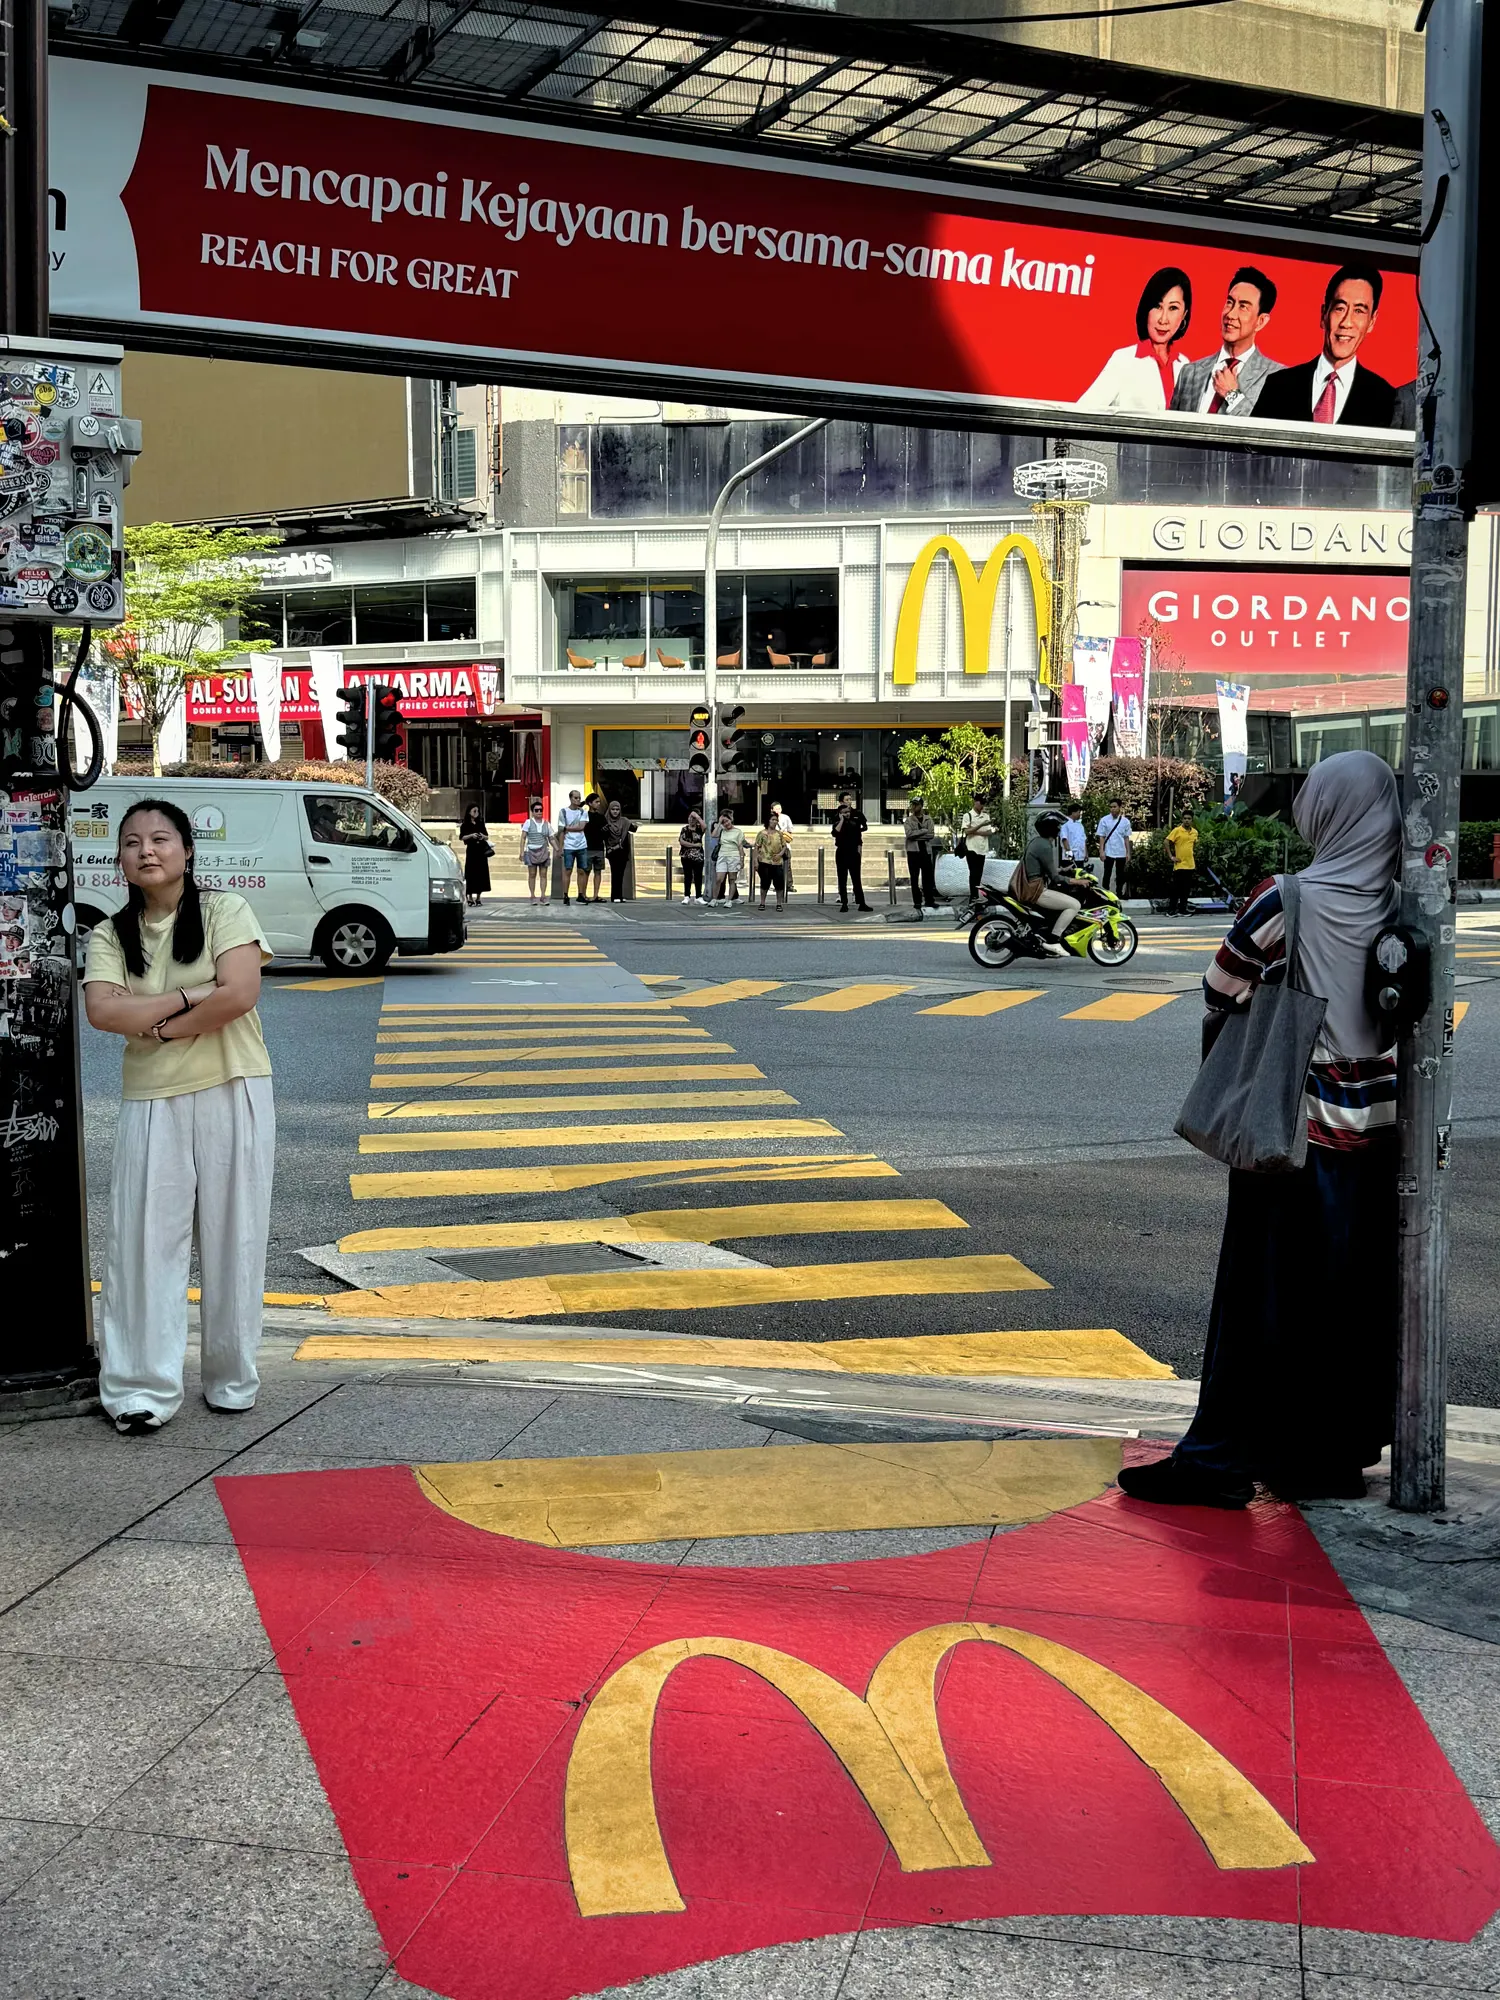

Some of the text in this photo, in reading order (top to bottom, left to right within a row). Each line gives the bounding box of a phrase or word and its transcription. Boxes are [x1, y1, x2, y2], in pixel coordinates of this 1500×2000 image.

[204, 144, 1096, 297] Mencapai Kejayaan bersama-sama kami
[200, 233, 519, 299] REACH FOR GREAT
[1148, 590, 1410, 622] GIORDANO
[1211, 629, 1351, 649] OUTLET
[193, 706, 223, 715] DONER
[400, 701, 476, 710] FRIED CHICKEN
[227, 875, 266, 888] 4958
